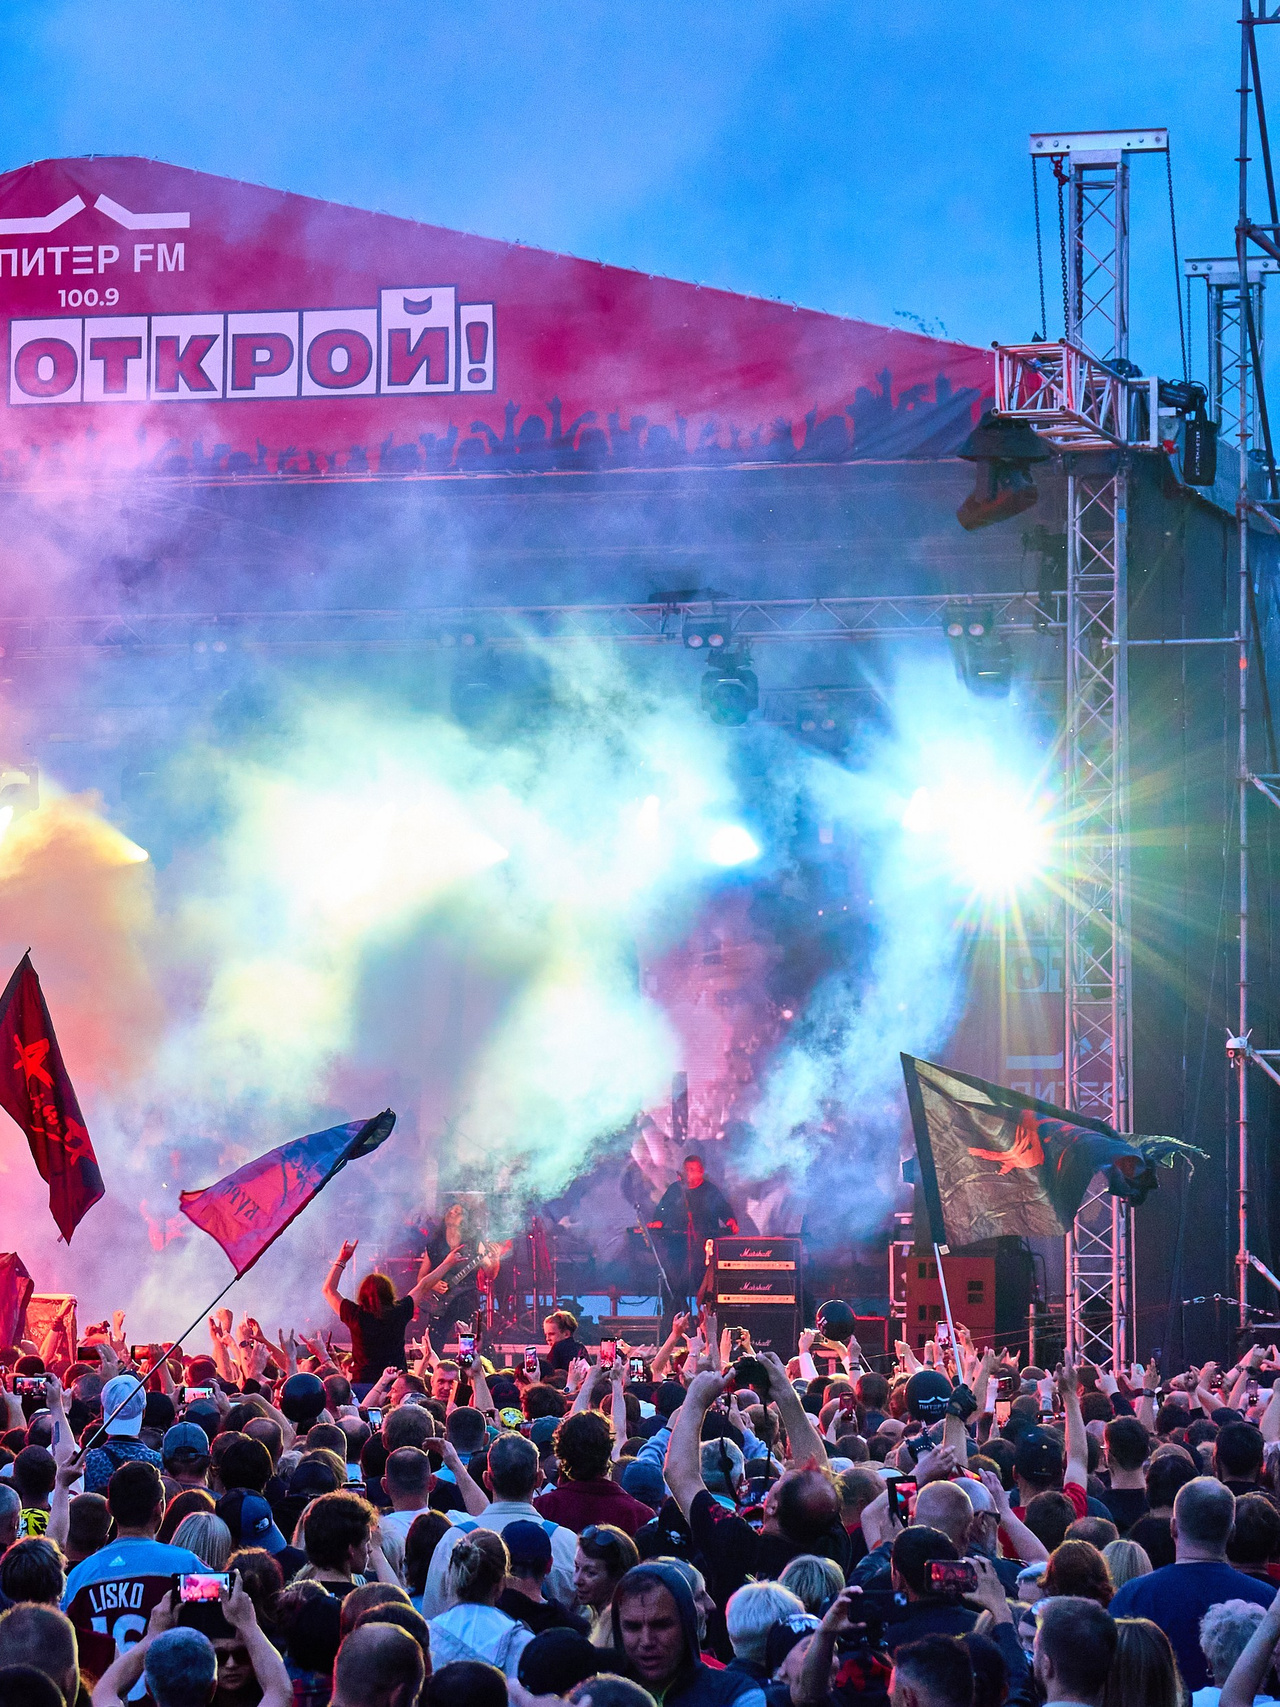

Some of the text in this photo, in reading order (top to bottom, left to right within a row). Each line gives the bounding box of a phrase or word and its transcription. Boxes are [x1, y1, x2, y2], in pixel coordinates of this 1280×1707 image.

[133, 242, 185, 273] FM
[57, 287, 120, 308] 100.9
[13, 293, 490, 399] ОТКРОЙ!
[740, 1247, 773, 1258] Marshall
[740, 1281, 773, 1291] Marshall
[89, 1582, 144, 1613] LISKO
